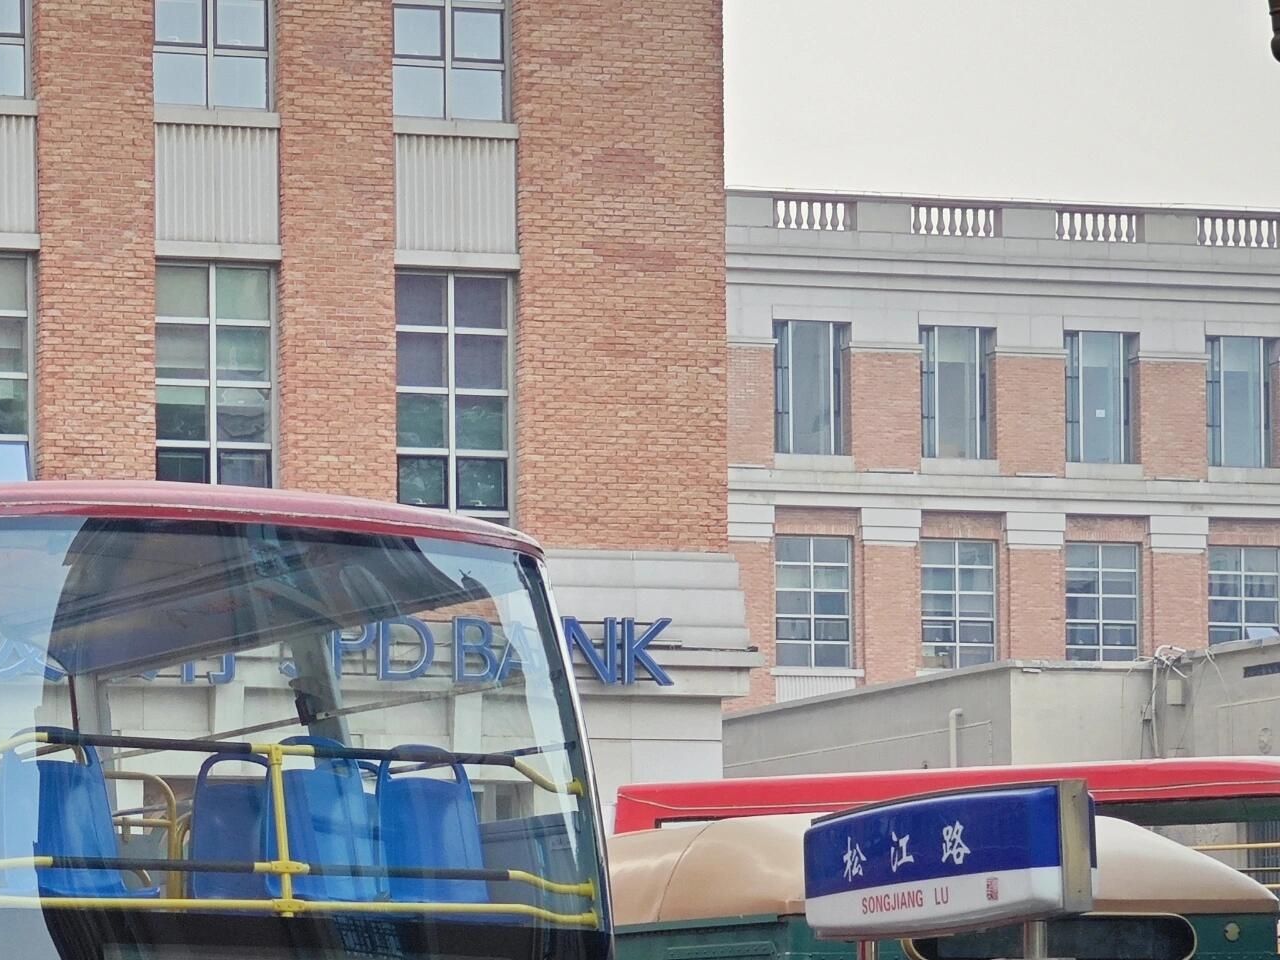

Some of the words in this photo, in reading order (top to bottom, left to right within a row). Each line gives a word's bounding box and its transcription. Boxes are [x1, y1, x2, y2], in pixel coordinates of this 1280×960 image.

[451, 615, 676, 687] BANK
[843, 820, 972, 883] 松江路
[862, 890, 924, 915] SONGJIANG
[934, 887, 950, 905] LU
